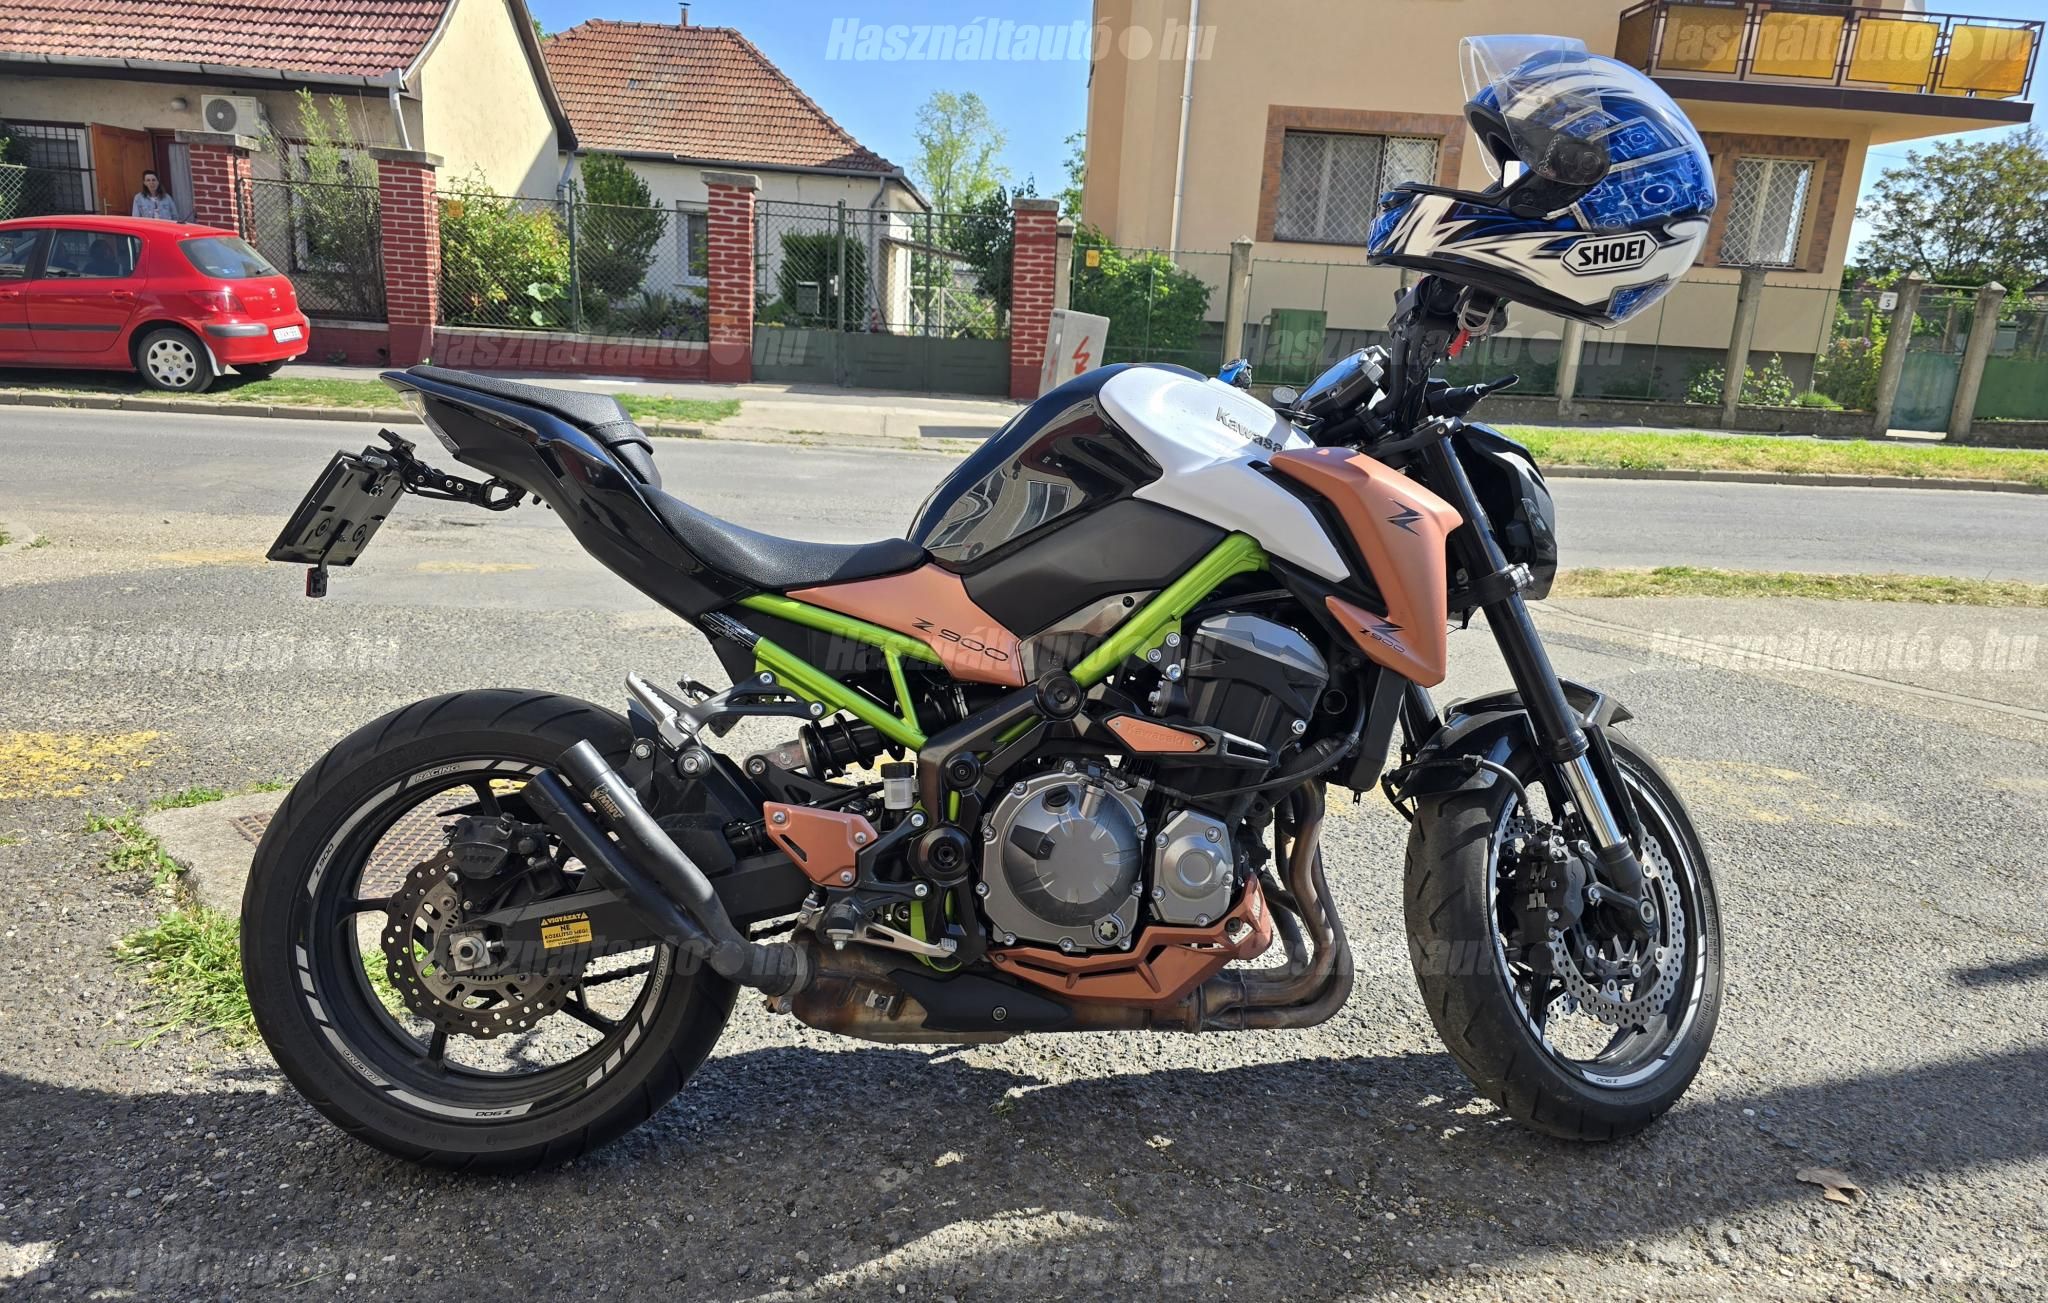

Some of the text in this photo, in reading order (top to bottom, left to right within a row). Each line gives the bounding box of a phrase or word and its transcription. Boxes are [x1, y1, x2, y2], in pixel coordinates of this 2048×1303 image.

[1578, 239, 1646, 267] SHOEI
[1216, 406, 1285, 453] Kawasa
[936, 628, 1009, 662] 900
[1127, 723, 1185, 746] Kawasaki
[415, 765, 459, 783] RACING
[560, 924, 571, 932] NE
[342, 1049, 380, 1082] RACING
